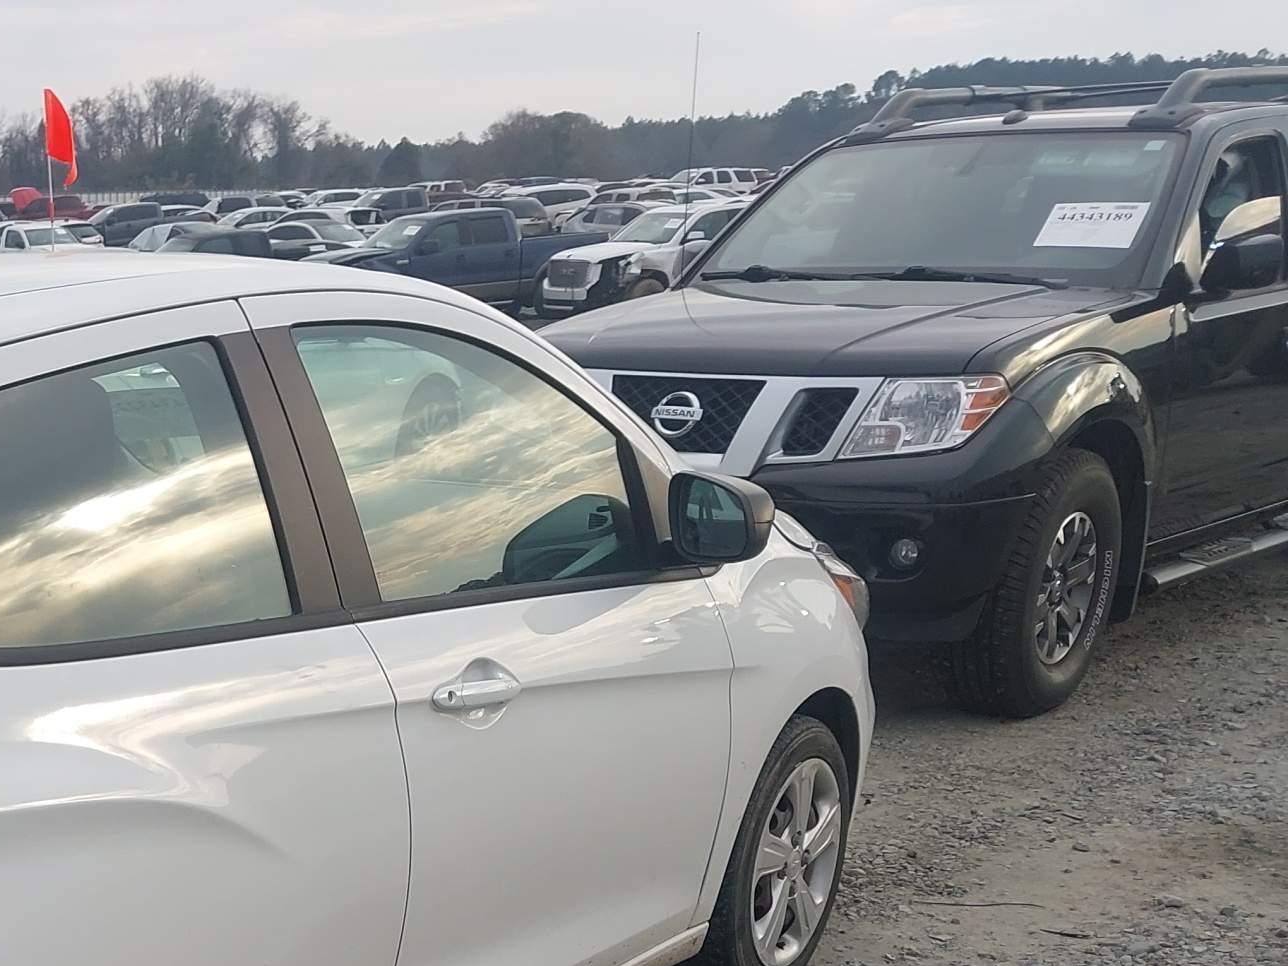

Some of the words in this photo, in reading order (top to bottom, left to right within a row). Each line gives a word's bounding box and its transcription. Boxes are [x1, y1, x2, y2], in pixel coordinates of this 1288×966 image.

[1057, 212, 1133, 221] 44343189
[655, 408, 696, 418] NISSAN
[1083, 550, 1113, 651] MICHELIN
